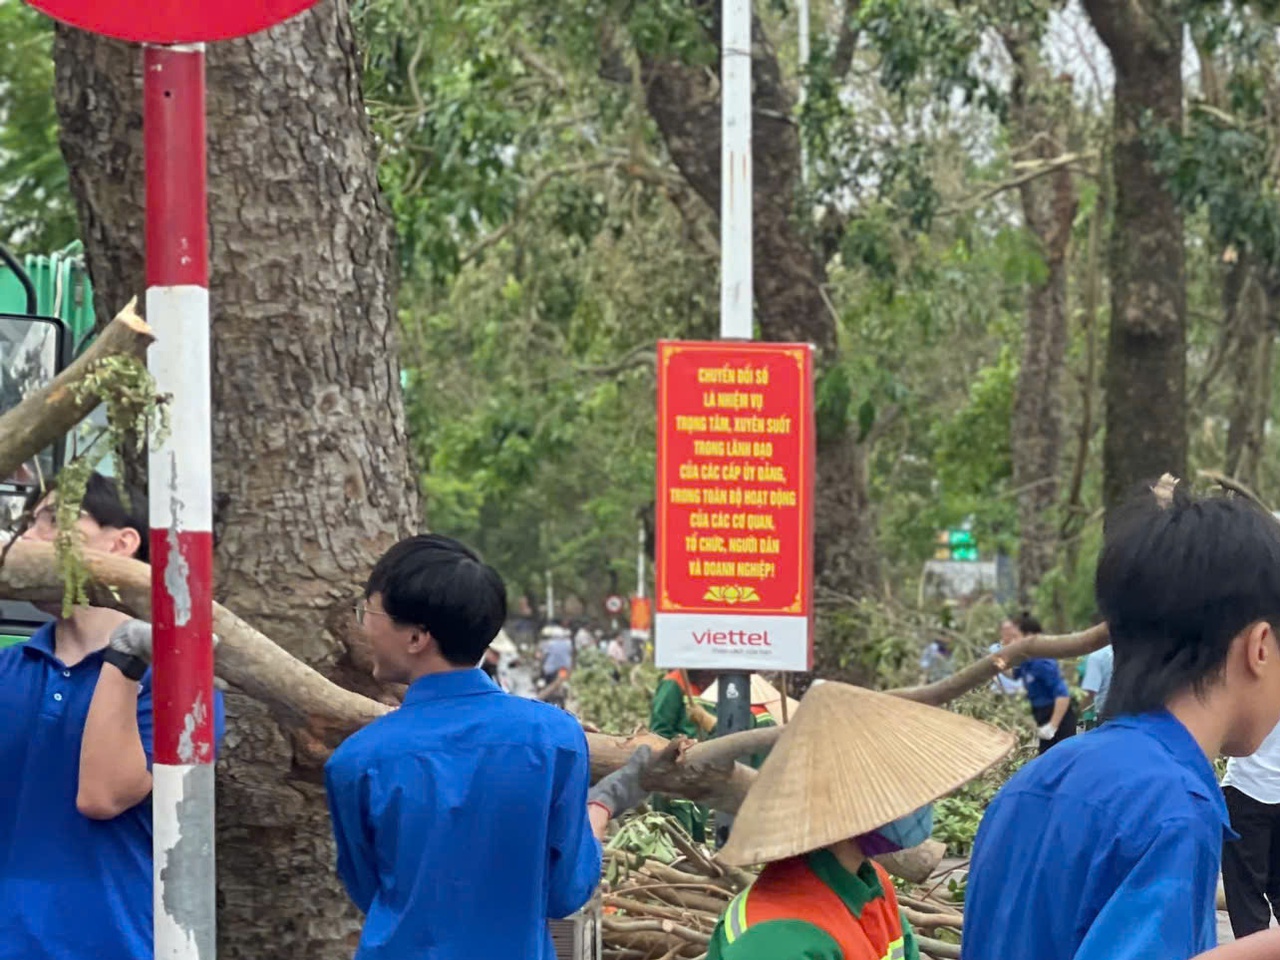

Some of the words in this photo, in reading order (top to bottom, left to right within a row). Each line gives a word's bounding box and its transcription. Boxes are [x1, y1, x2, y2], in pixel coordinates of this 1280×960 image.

[698, 364, 735, 383] CHUYỂN
[737, 364, 753, 384] ĐỔI
[755, 365, 769, 385] SỐ
[703, 391, 716, 407] LÀ
[718, 390, 748, 411] NHIỆM
[750, 393, 763, 411] VỤ
[676, 415, 707, 434] TRỌNG
[734, 415, 765, 433] XUYÊN
[767, 413, 791, 434] SUỐT
[694, 440, 724, 456] TRONG
[726, 439, 751, 457] LÃNH
[753, 442, 773, 460] ĐẠO
[679, 460, 699, 479] CỦA
[701, 462, 720, 480] CÁC
[722, 461, 742, 481] CẤP
[670, 488, 701, 504] TRONG
[703, 487, 727, 504] TOÀN
[729, 487, 742, 508] BỘ
[744, 490, 768, 508] HOẠT
[770, 488, 796, 509] ĐỘNG
[690, 509, 709, 528] CỦA
[711, 511, 730, 529] CÁC
[732, 512, 746, 529] CƠ
[685, 532, 697, 552] TỔ
[729, 535, 757, 553] NGƯỜI
[760, 536, 780, 554] DÂN
[689, 558, 701, 576] VÀ
[703, 561, 735, 577] DOANH
[692, 628, 772, 646] viettel
